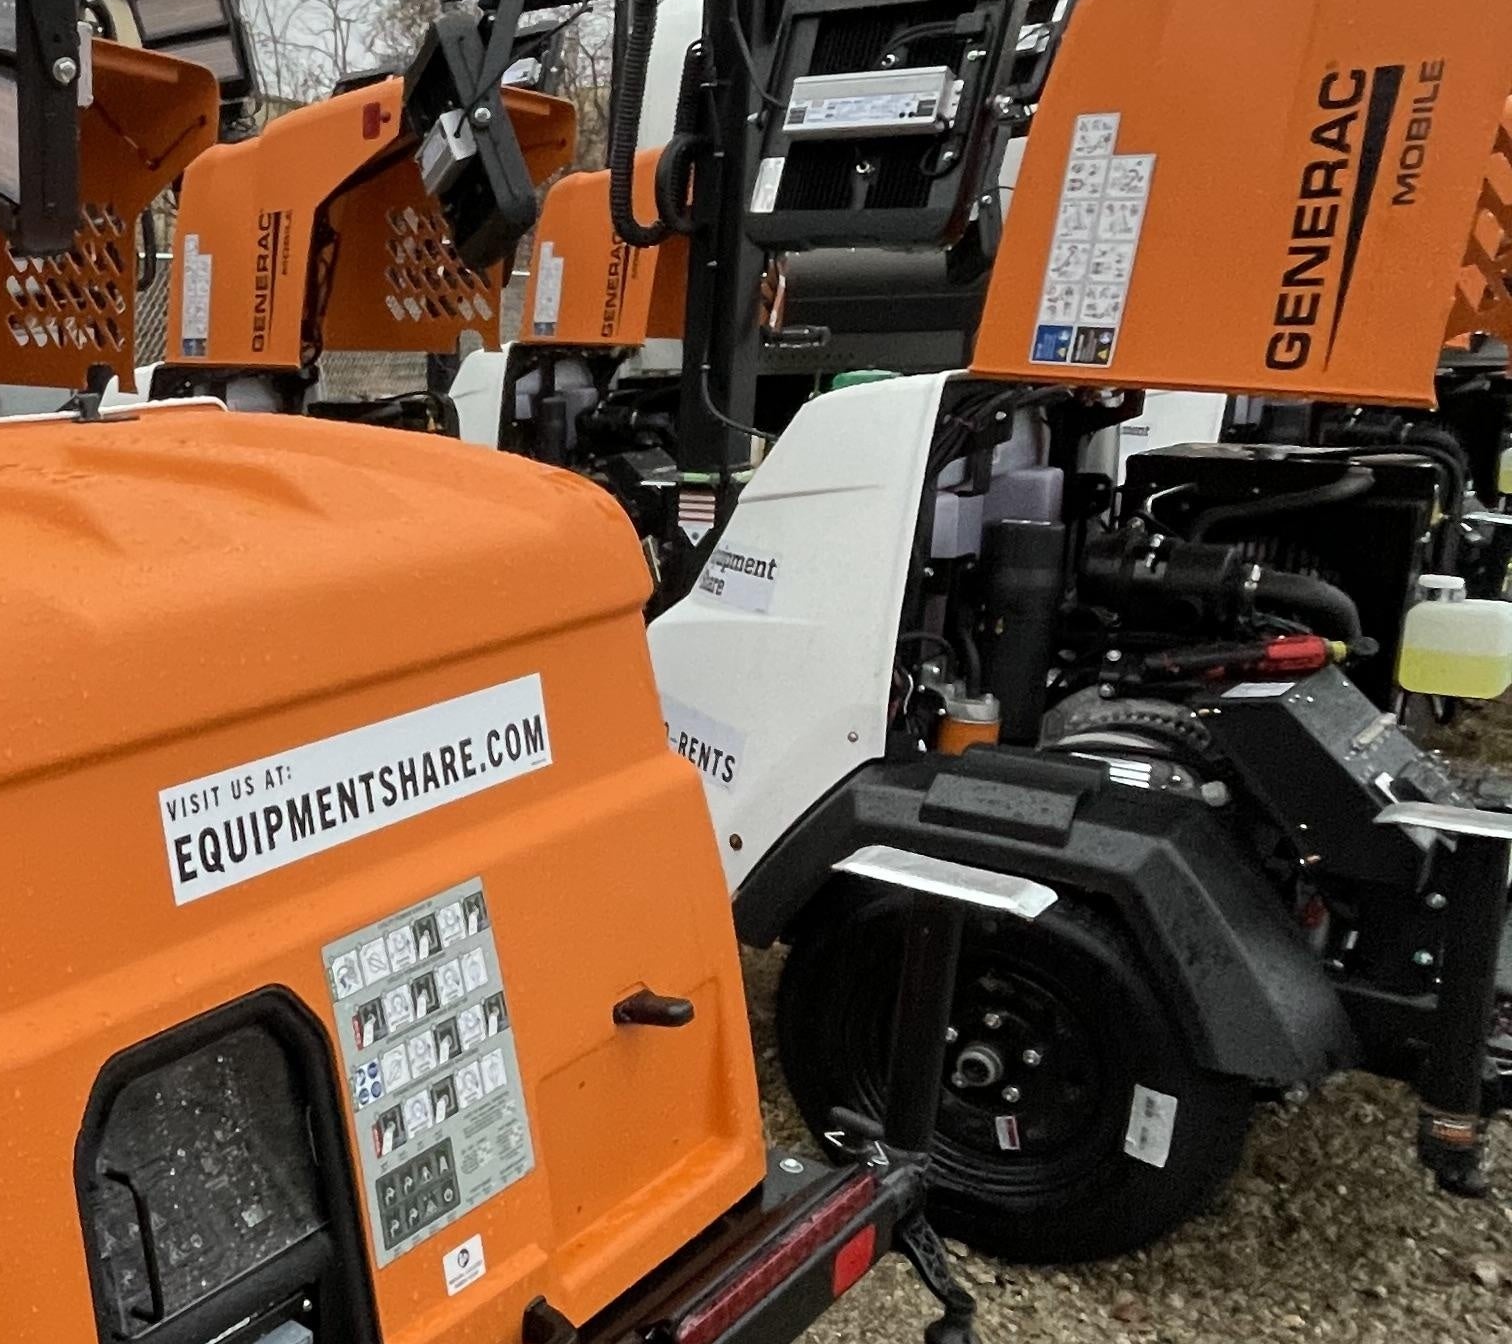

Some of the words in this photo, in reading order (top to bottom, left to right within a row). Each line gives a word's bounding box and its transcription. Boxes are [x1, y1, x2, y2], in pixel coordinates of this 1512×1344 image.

[1391, 58, 1446, 206] MOBILE
[252, 212, 272, 352] GENERAC
[1264, 67, 1367, 371] GENERAC
[166, 785, 220, 822] VISIT
[230, 775, 255, 801] US
[264, 764, 292, 790] AT:
[174, 714, 545, 884] EQUIPMENTSHARE.COM
[664, 720, 736, 784] -RENTS
